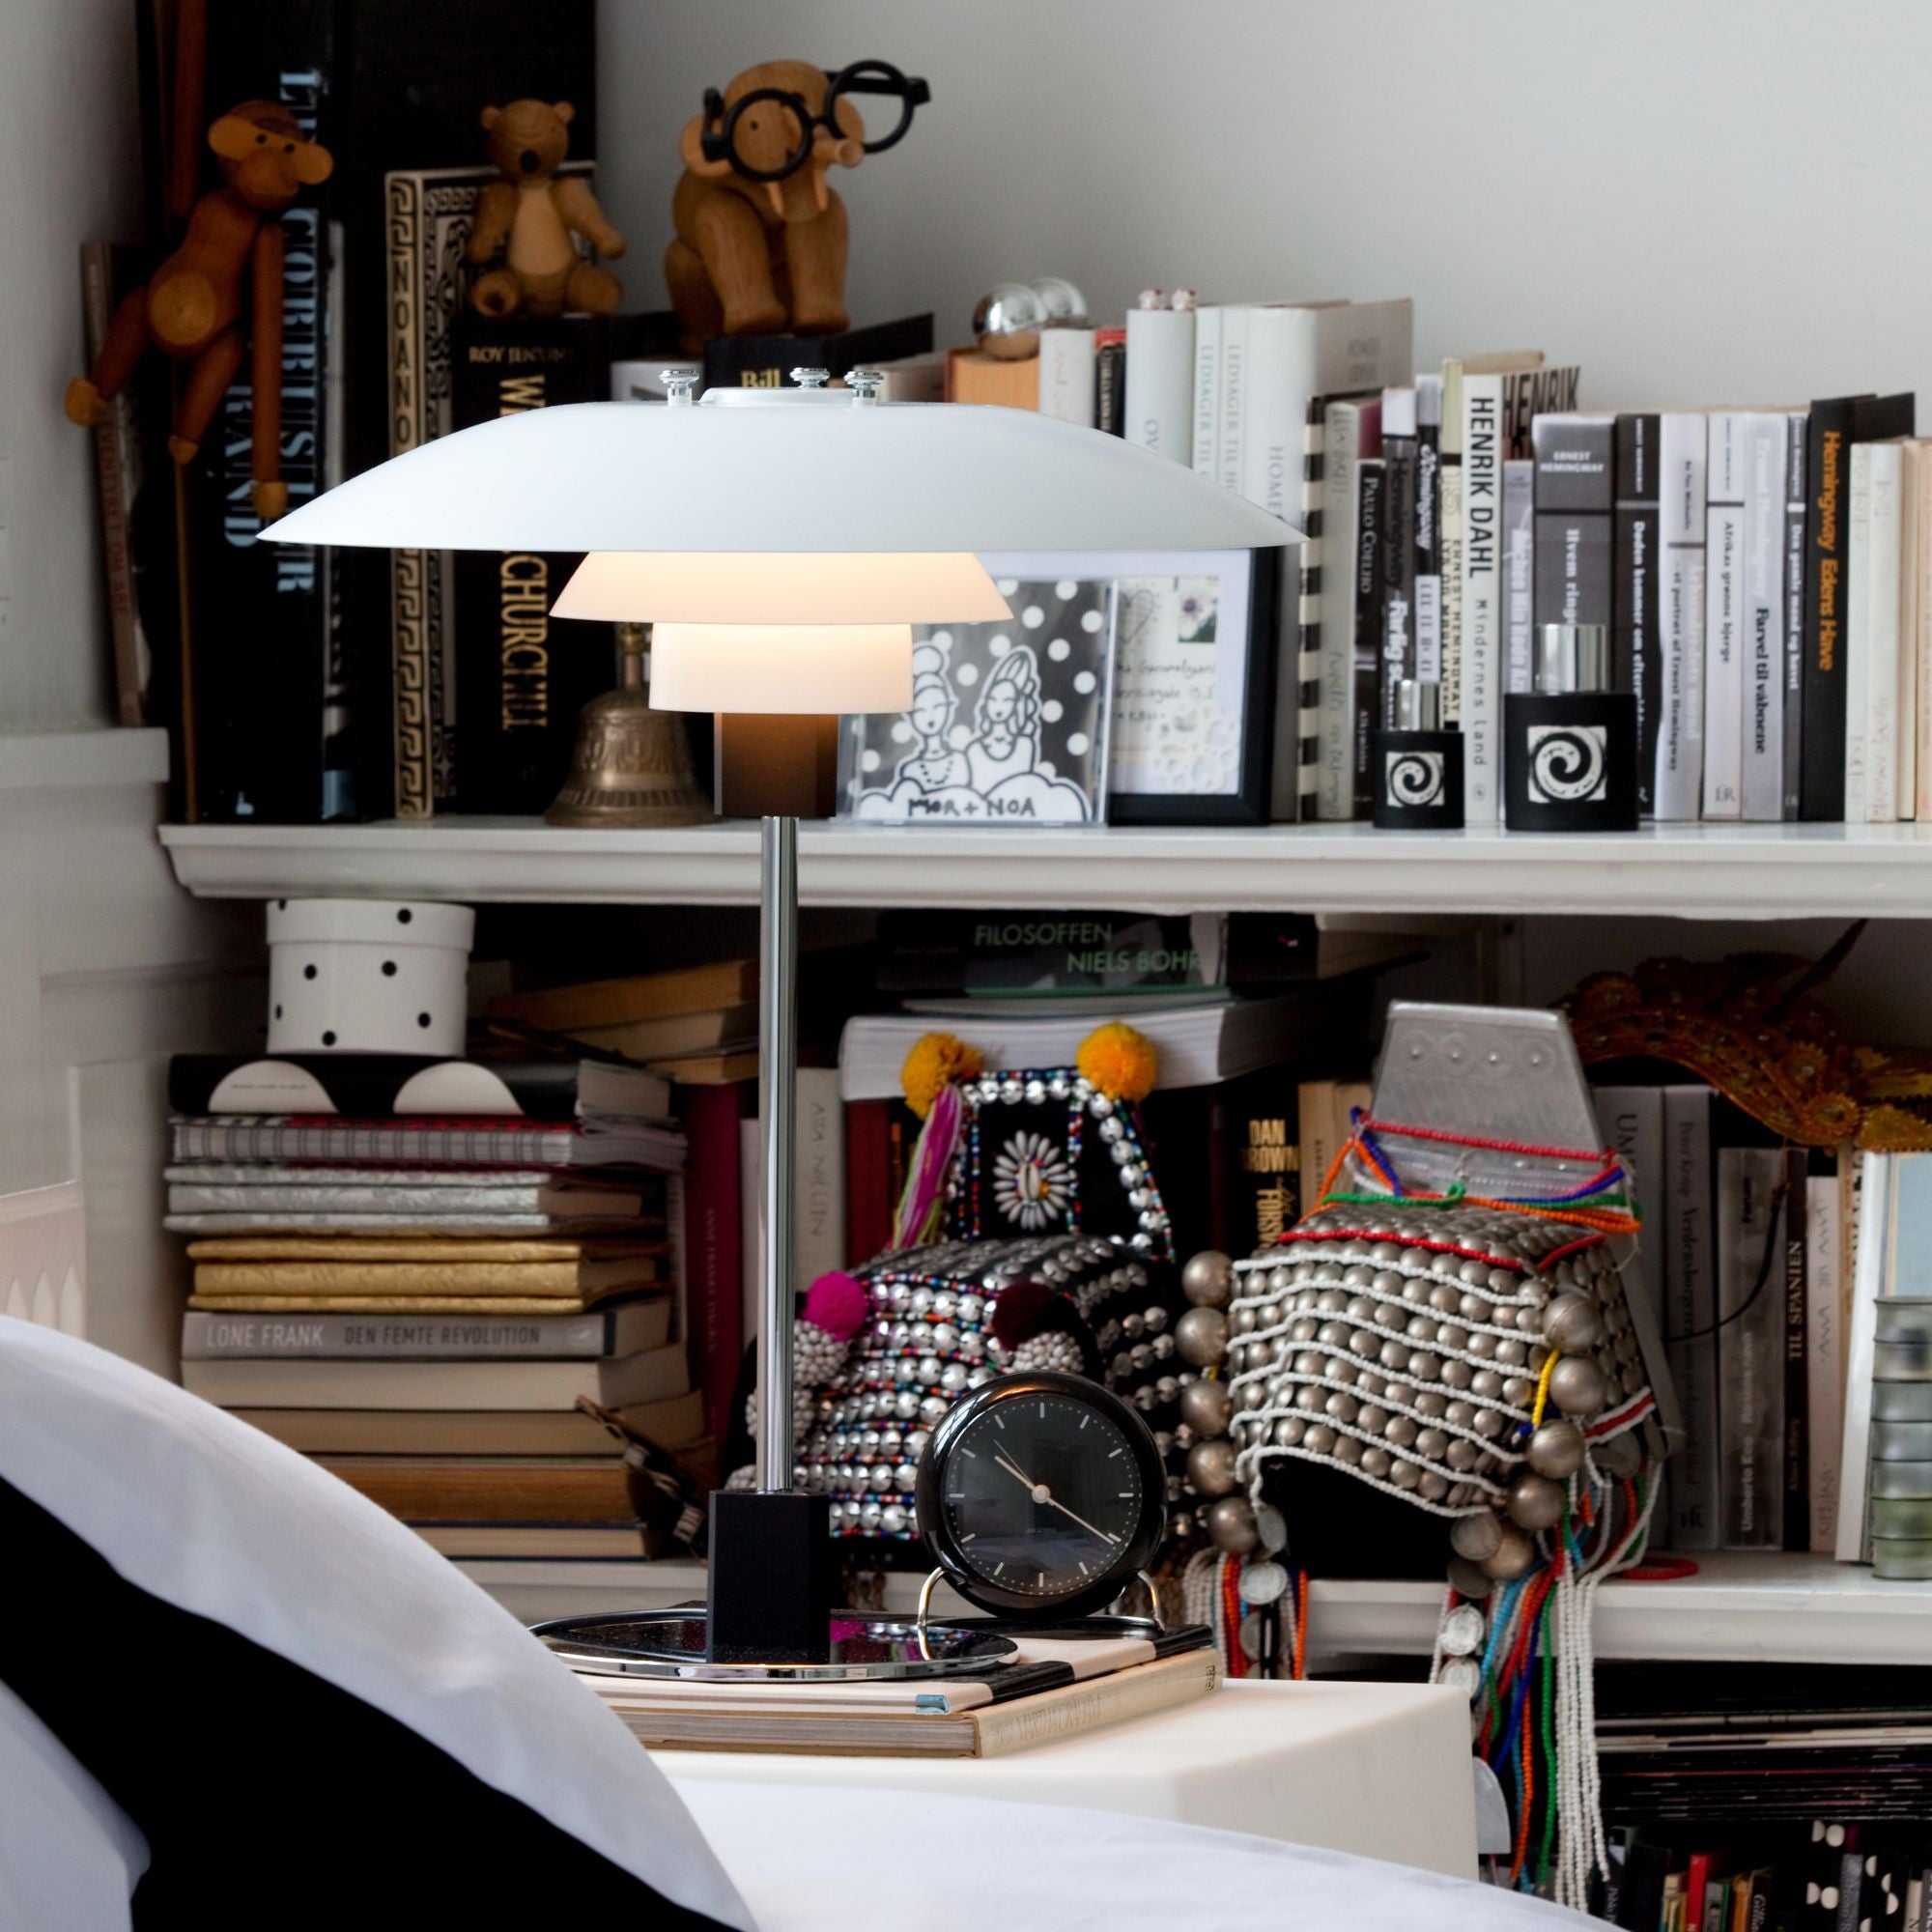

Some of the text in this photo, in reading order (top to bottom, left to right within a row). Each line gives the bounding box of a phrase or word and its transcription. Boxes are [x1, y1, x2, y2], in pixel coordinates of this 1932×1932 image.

[275, 207, 319, 595] CORBUSIR
[1225, 344, 1242, 432] LEDSAGER
[1539, 462, 1605, 473] HEMINGWAY
[1553, 451, 1592, 461] ERNEST
[1360, 477, 1378, 594] PAULO COELHO
[1566, 528, 1579, 578] Hvem
[1633, 521, 1646, 565] Døden
[1817, 430, 1841, 671] Hemingway Edens Have
[1468, 397, 1495, 766] HENRIK DAHL Mindernes land
[1633, 568, 1646, 624] kommer
[1719, 521, 1735, 664] Afrikas grønne bjerge
[1786, 525, 1803, 690] Den gamle mand og havet
[497, 554, 549, 731] CHURCHILL
[1633, 628, 1644, 650] om
[1670, 656, 1683, 695] Ernest
[1754, 608, 1770, 754] Farvel til våbnene
[1666, 698, 1682, 772] Hemingway
[987, 798, 1036, 816] NOA
[974, 922, 1114, 947] FILOSOFFEN
[1066, 952, 1129, 974] NIELS
[1249, 1118, 1286, 1146] DAN
[1787, 1240, 1804, 1325] SPANIEN
[206, 1323, 541, 1348] LONE FRANK DEN FEMTE REVOLUTION
[1788, 1331, 1804, 1361] TIL
[1741, 1435, 1754, 1464] Eco
[1741, 1467, 1754, 1532] Umberto
